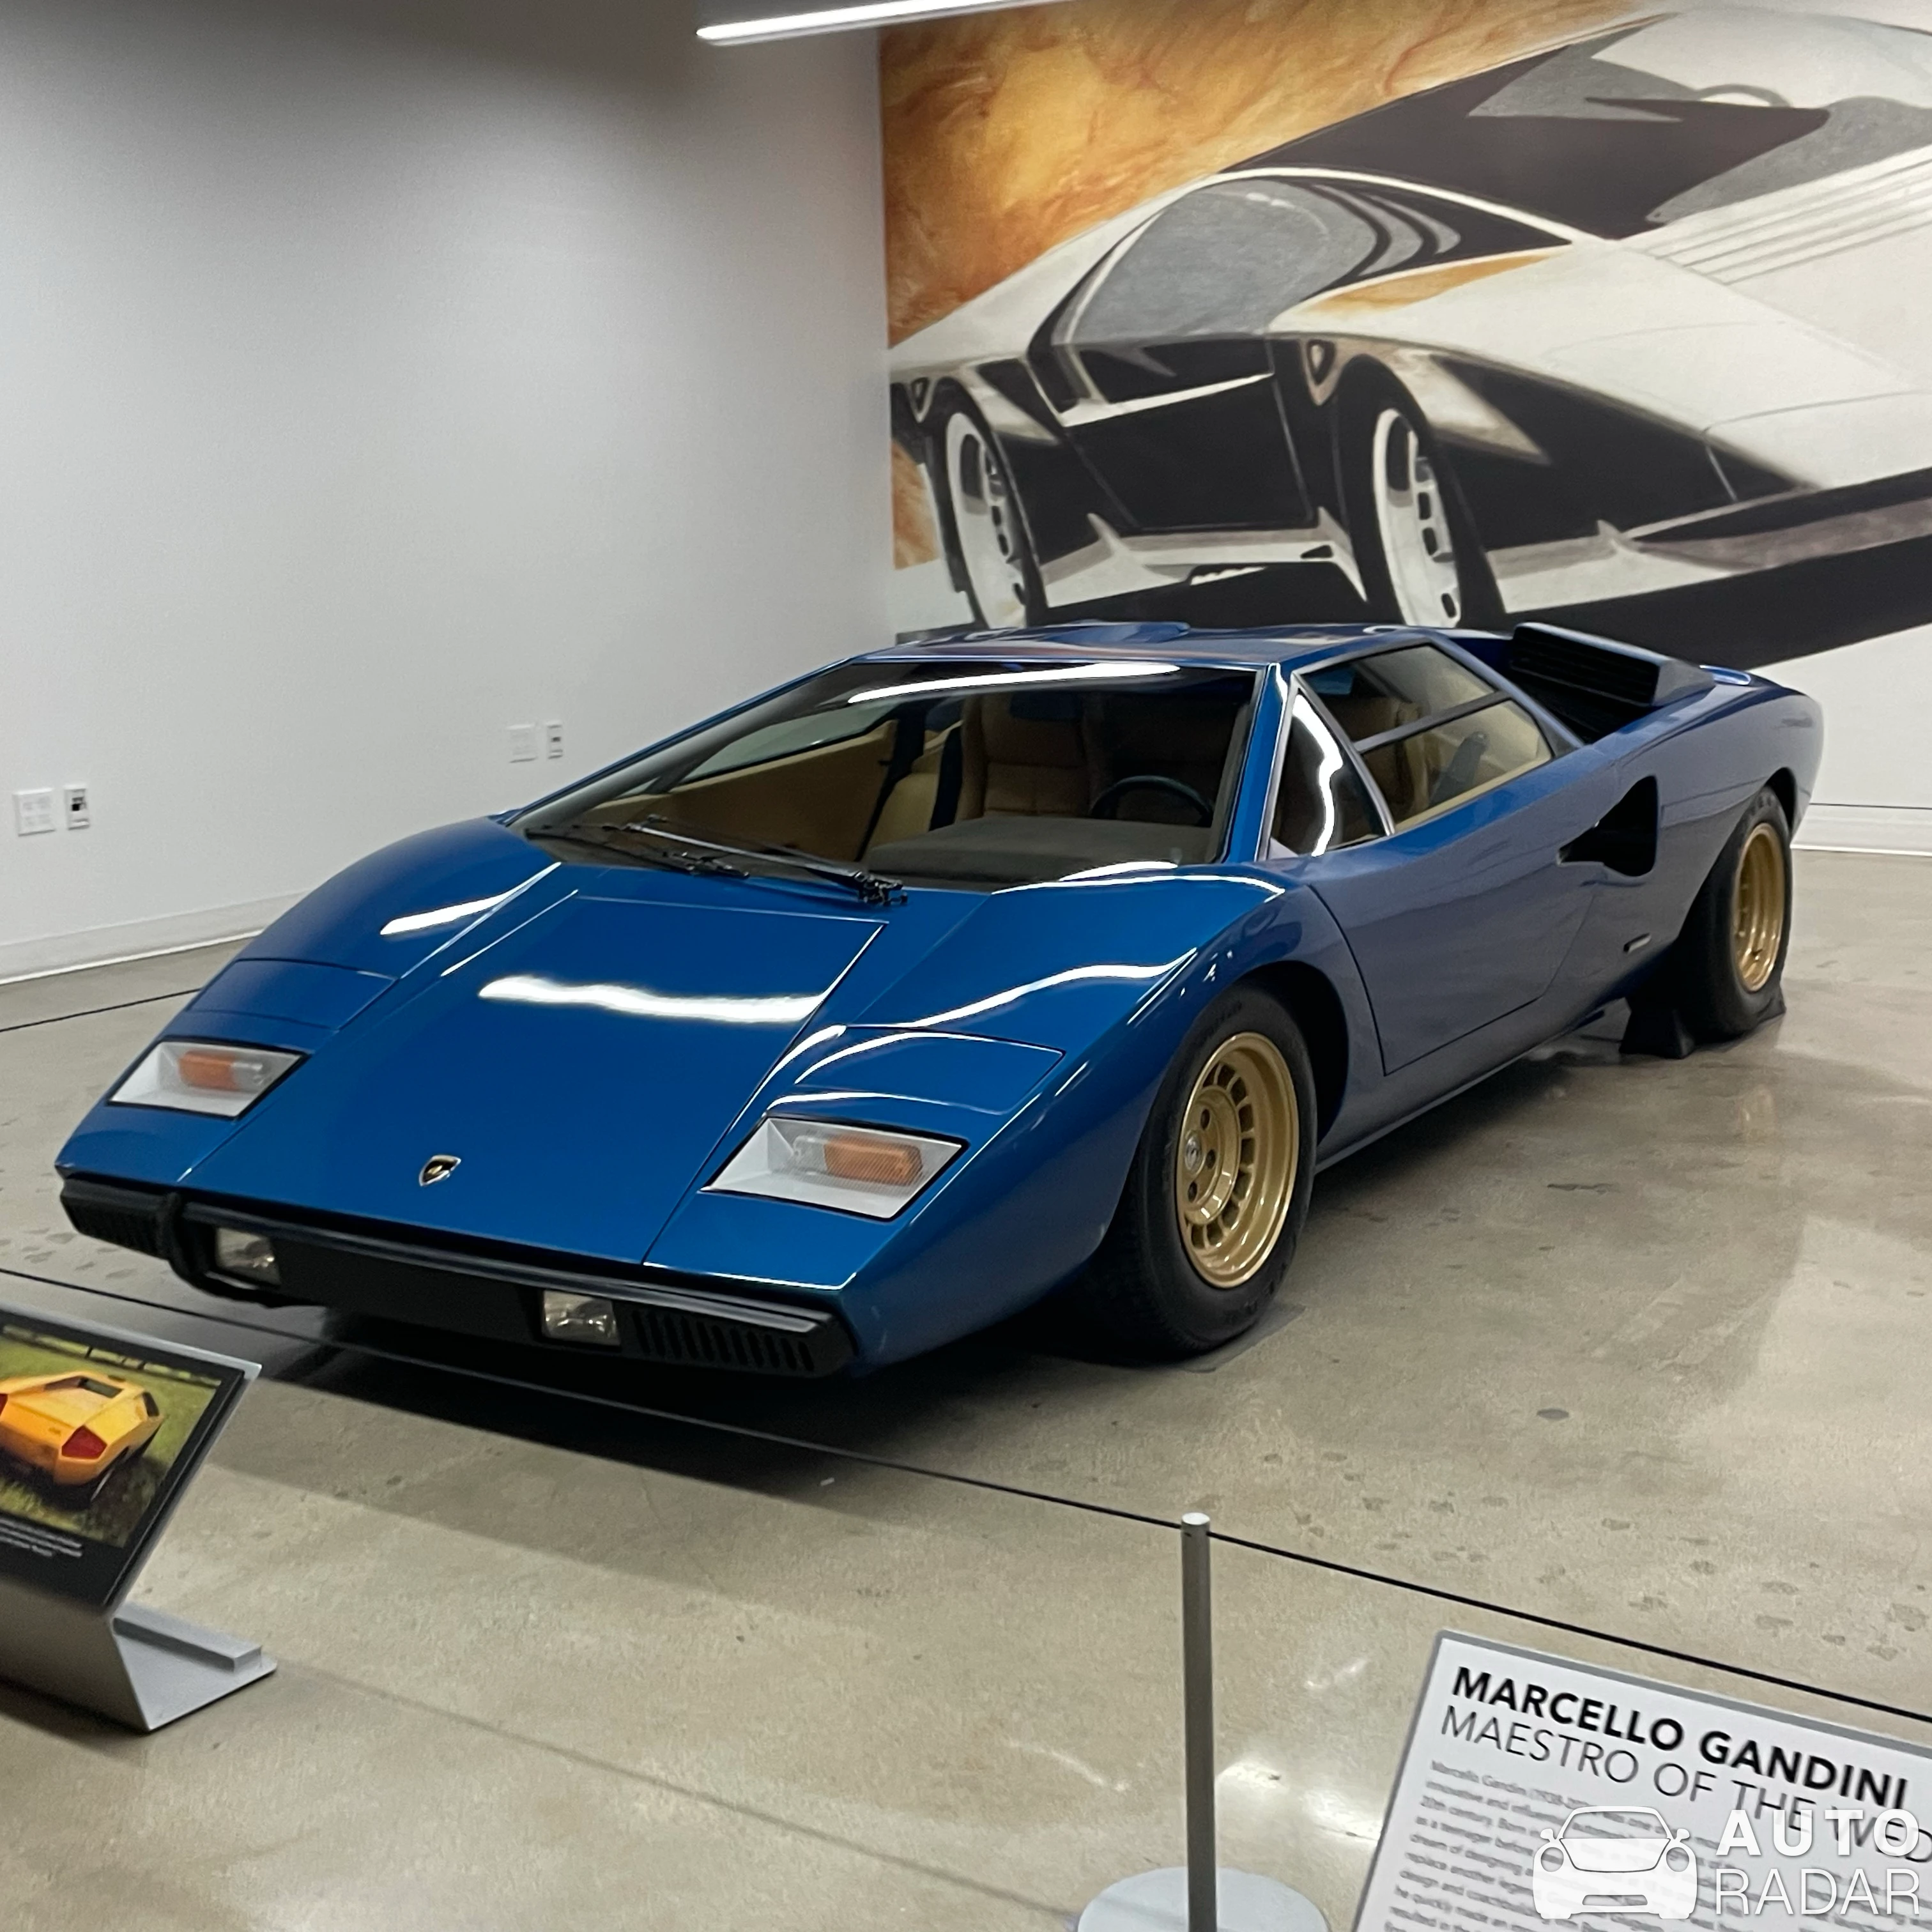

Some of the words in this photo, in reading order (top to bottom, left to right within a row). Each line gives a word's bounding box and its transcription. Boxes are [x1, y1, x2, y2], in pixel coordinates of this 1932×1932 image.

[1441, 1705, 1638, 1784] MAESTRO
[1654, 1763, 1717, 1802] OF
[1731, 1780, 1816, 1831] THE
[1452, 1666, 1683, 1752] MARCELLO
[1699, 1731, 1908, 1809] GANDINI
